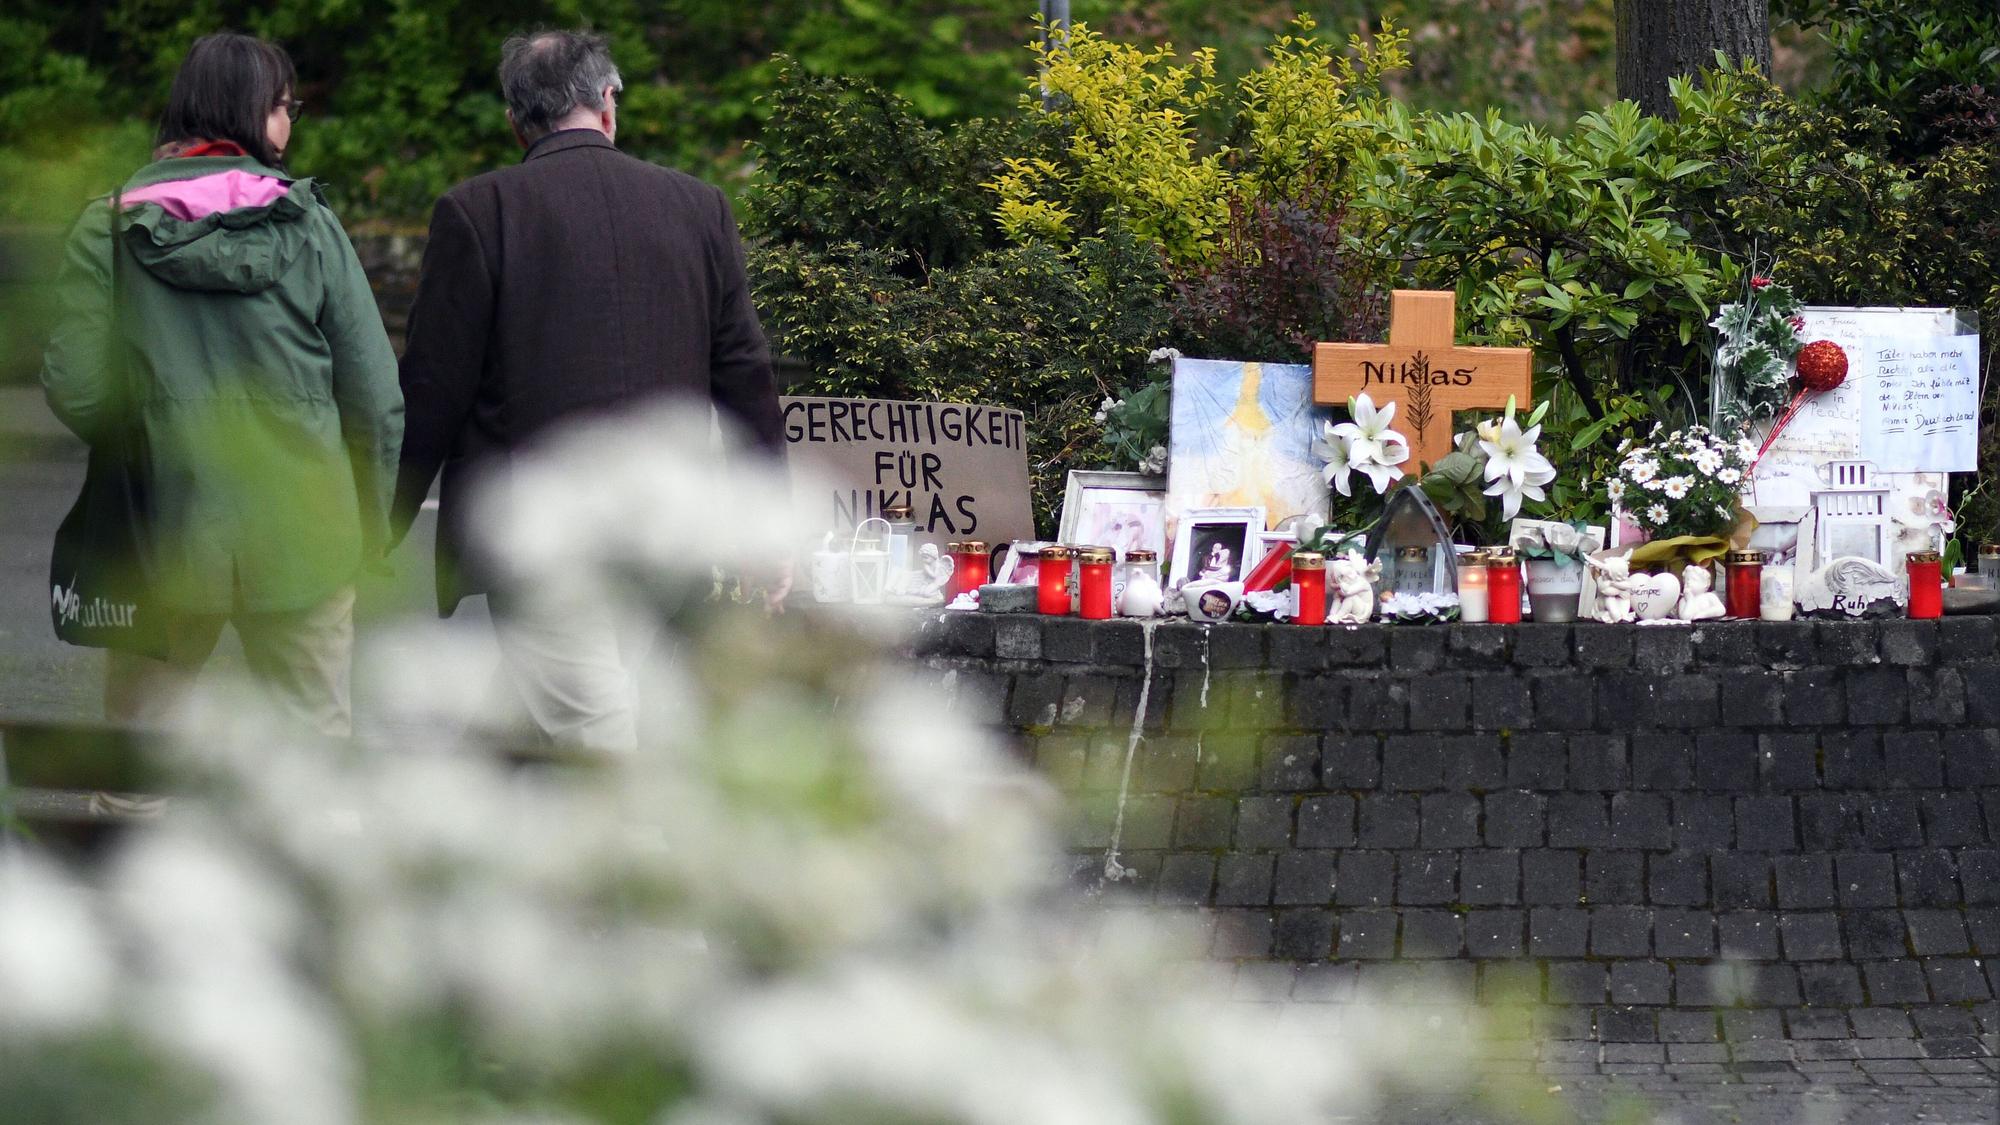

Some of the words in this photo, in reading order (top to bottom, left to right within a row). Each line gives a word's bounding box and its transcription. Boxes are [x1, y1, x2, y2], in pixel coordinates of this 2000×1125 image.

[1941, 349, 1963, 359] mehr
[1359, 360, 1477, 390] Niklas
[783, 401, 1024, 450] GERECHTIGKEIT
[875, 450, 943, 491] FÜR
